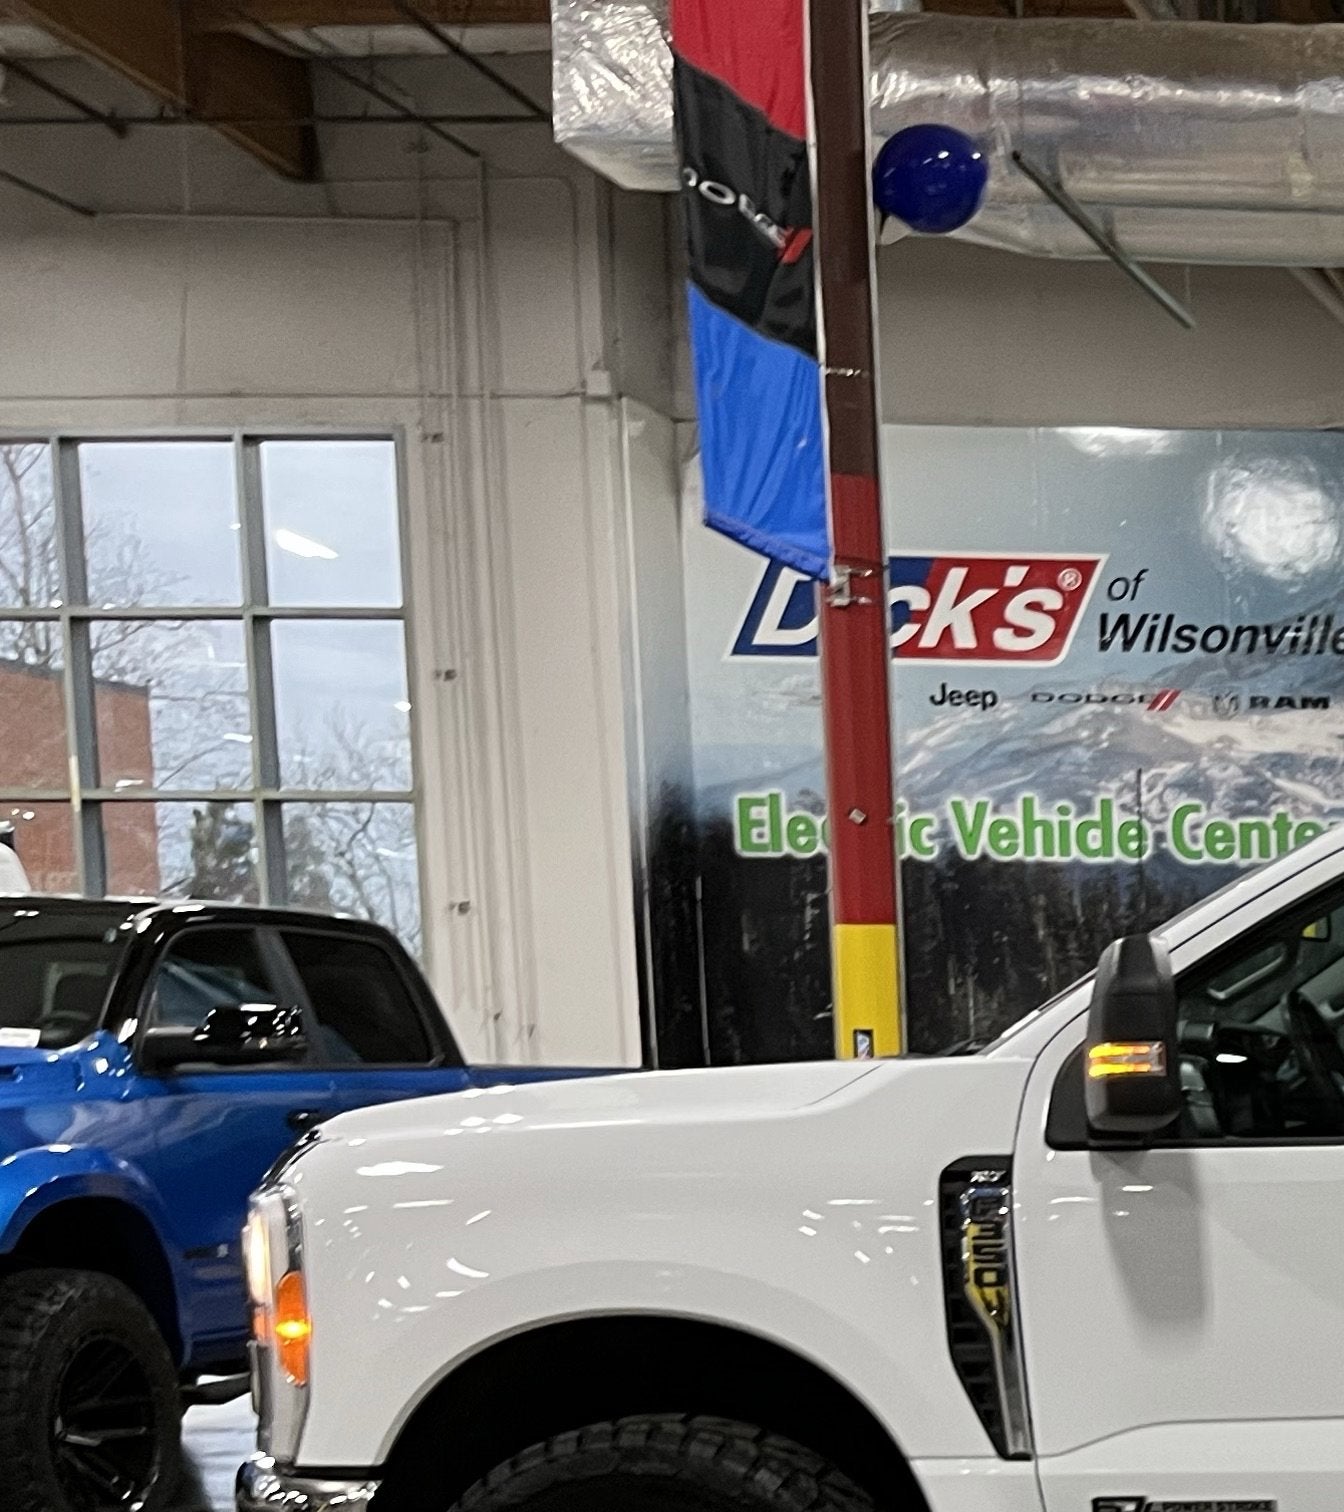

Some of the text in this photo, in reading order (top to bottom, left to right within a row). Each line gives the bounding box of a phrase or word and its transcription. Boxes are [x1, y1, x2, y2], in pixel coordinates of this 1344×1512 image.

[751, 564, 1064, 652] Dck's
[1106, 568, 1149, 601] of
[929, 683, 998, 709] Jeep
[1249, 695, 1330, 709] RAM
[950, 795, 1149, 859] Vehicle
[1171, 803, 1343, 860] Cente
